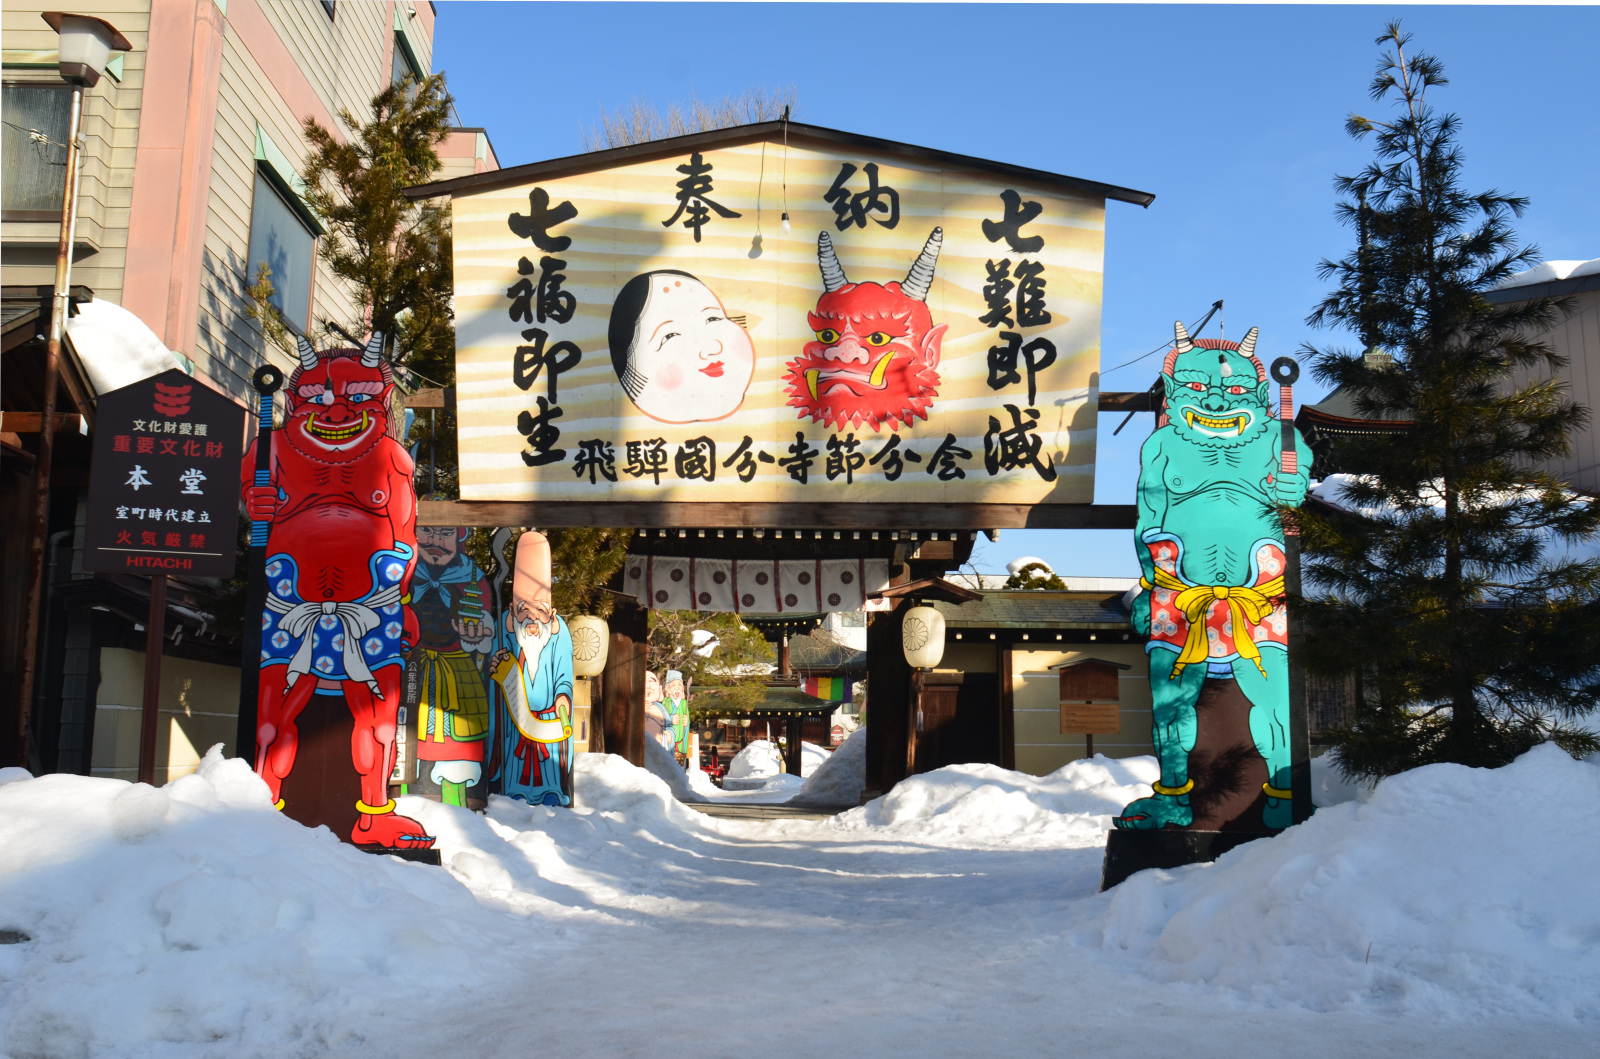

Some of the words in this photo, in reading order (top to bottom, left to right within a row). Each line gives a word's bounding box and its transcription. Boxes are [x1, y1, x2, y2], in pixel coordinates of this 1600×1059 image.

[508, 187, 583, 467] 七福即生
[978, 189, 1057, 483] 七難即滅
[132, 419, 208, 437] 文化財愛護
[112, 435, 224, 459] 重要文化財
[124, 465, 207, 495] 本堂
[115, 505, 212, 523] 室町時代建立
[116, 530, 206, 549] 火気厳禁
[126, 556, 193, 570] HITACHI
[406, 661, 418, 704] 公衆便所
